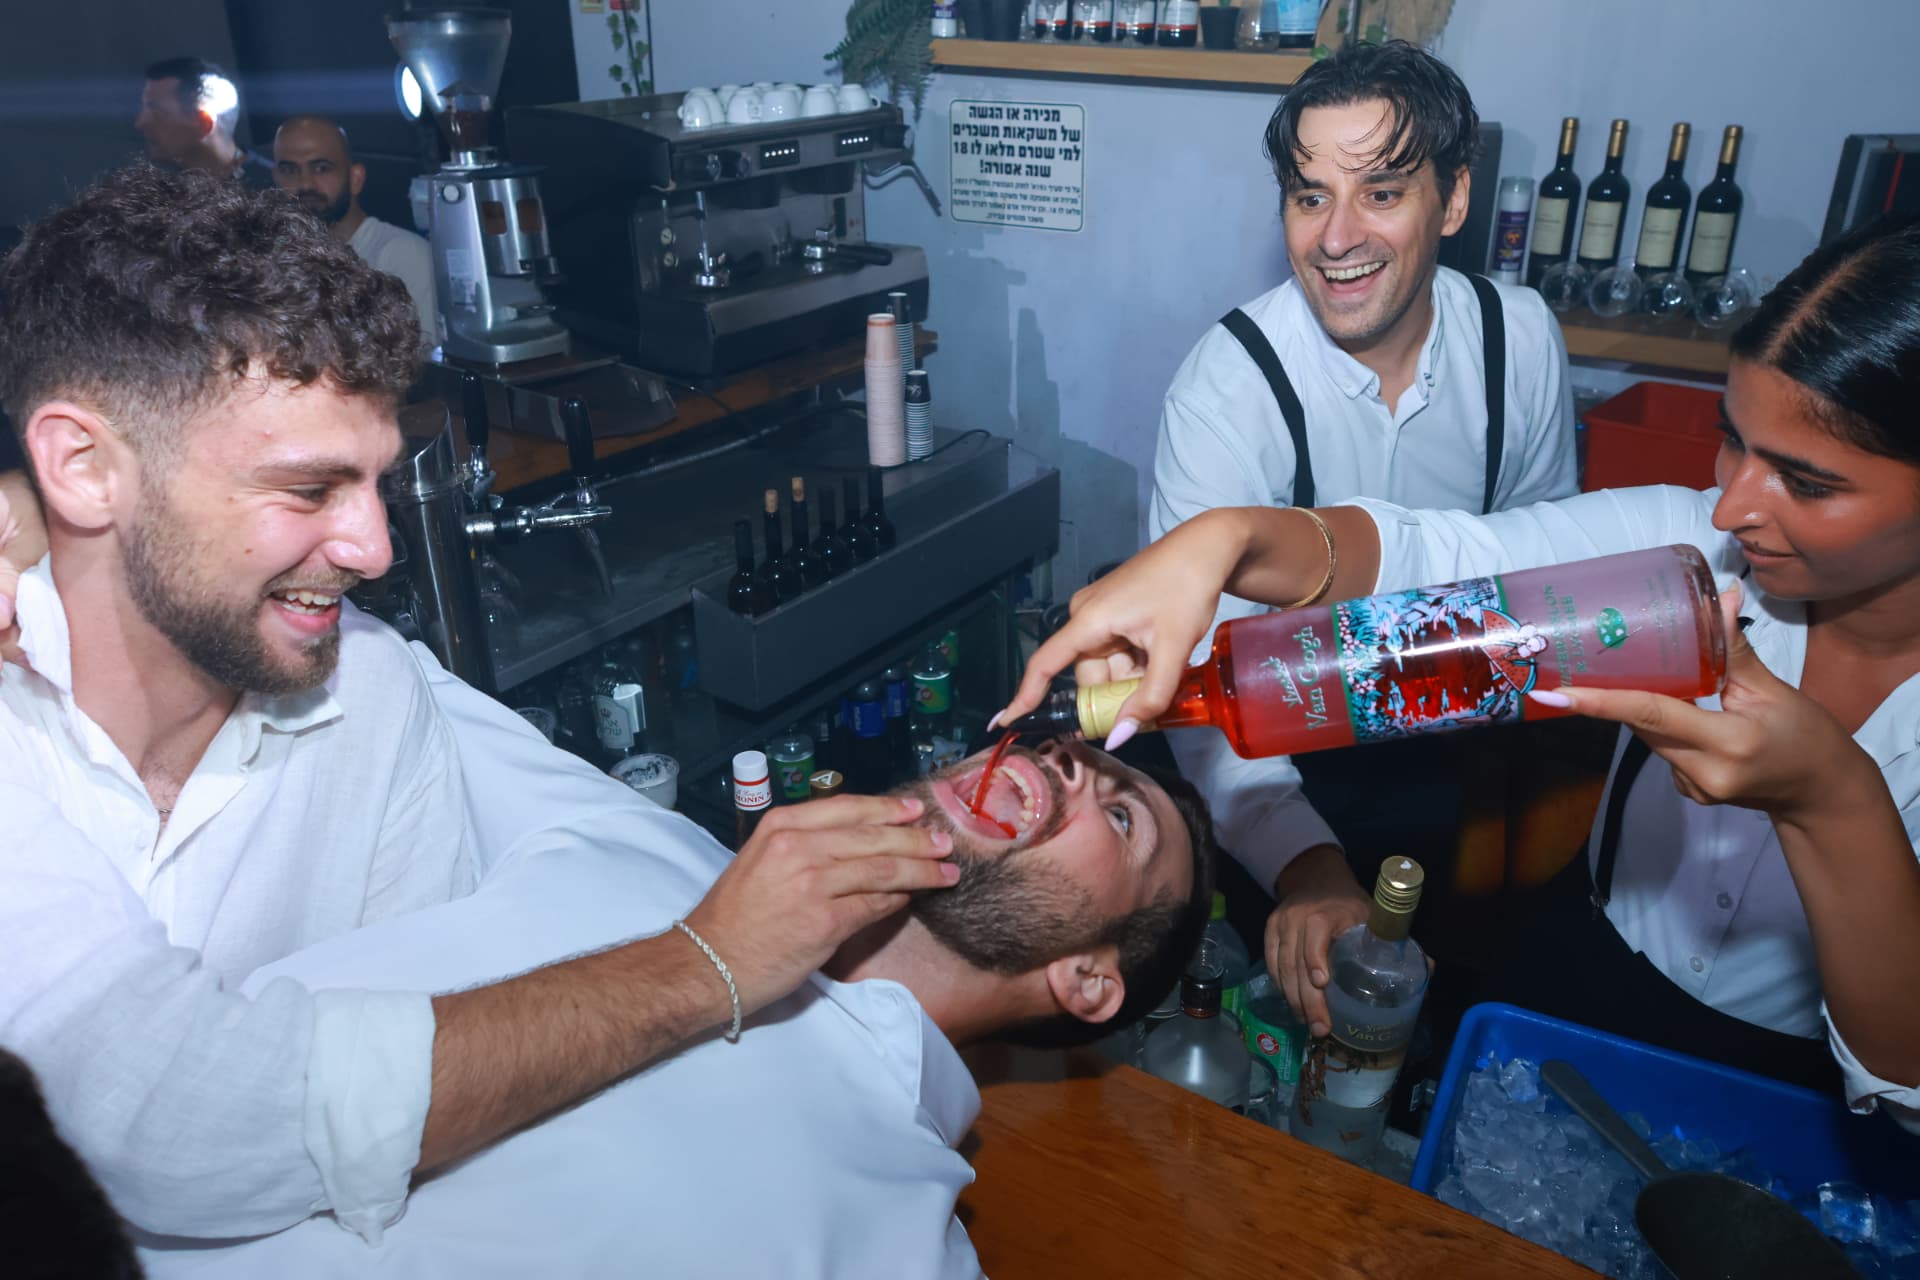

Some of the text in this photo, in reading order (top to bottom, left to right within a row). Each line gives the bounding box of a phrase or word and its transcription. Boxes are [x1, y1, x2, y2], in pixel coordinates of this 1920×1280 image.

[969, 106, 1060, 122] מכירה או הגשה
[953, 123, 1081, 142] של משקאות משכרים
[954, 139, 1080, 161] למי שטרם מלאו לו 18
[980, 160, 1051, 178] שנה אסורה!
[1292, 625, 1328, 731] Van Gogh
